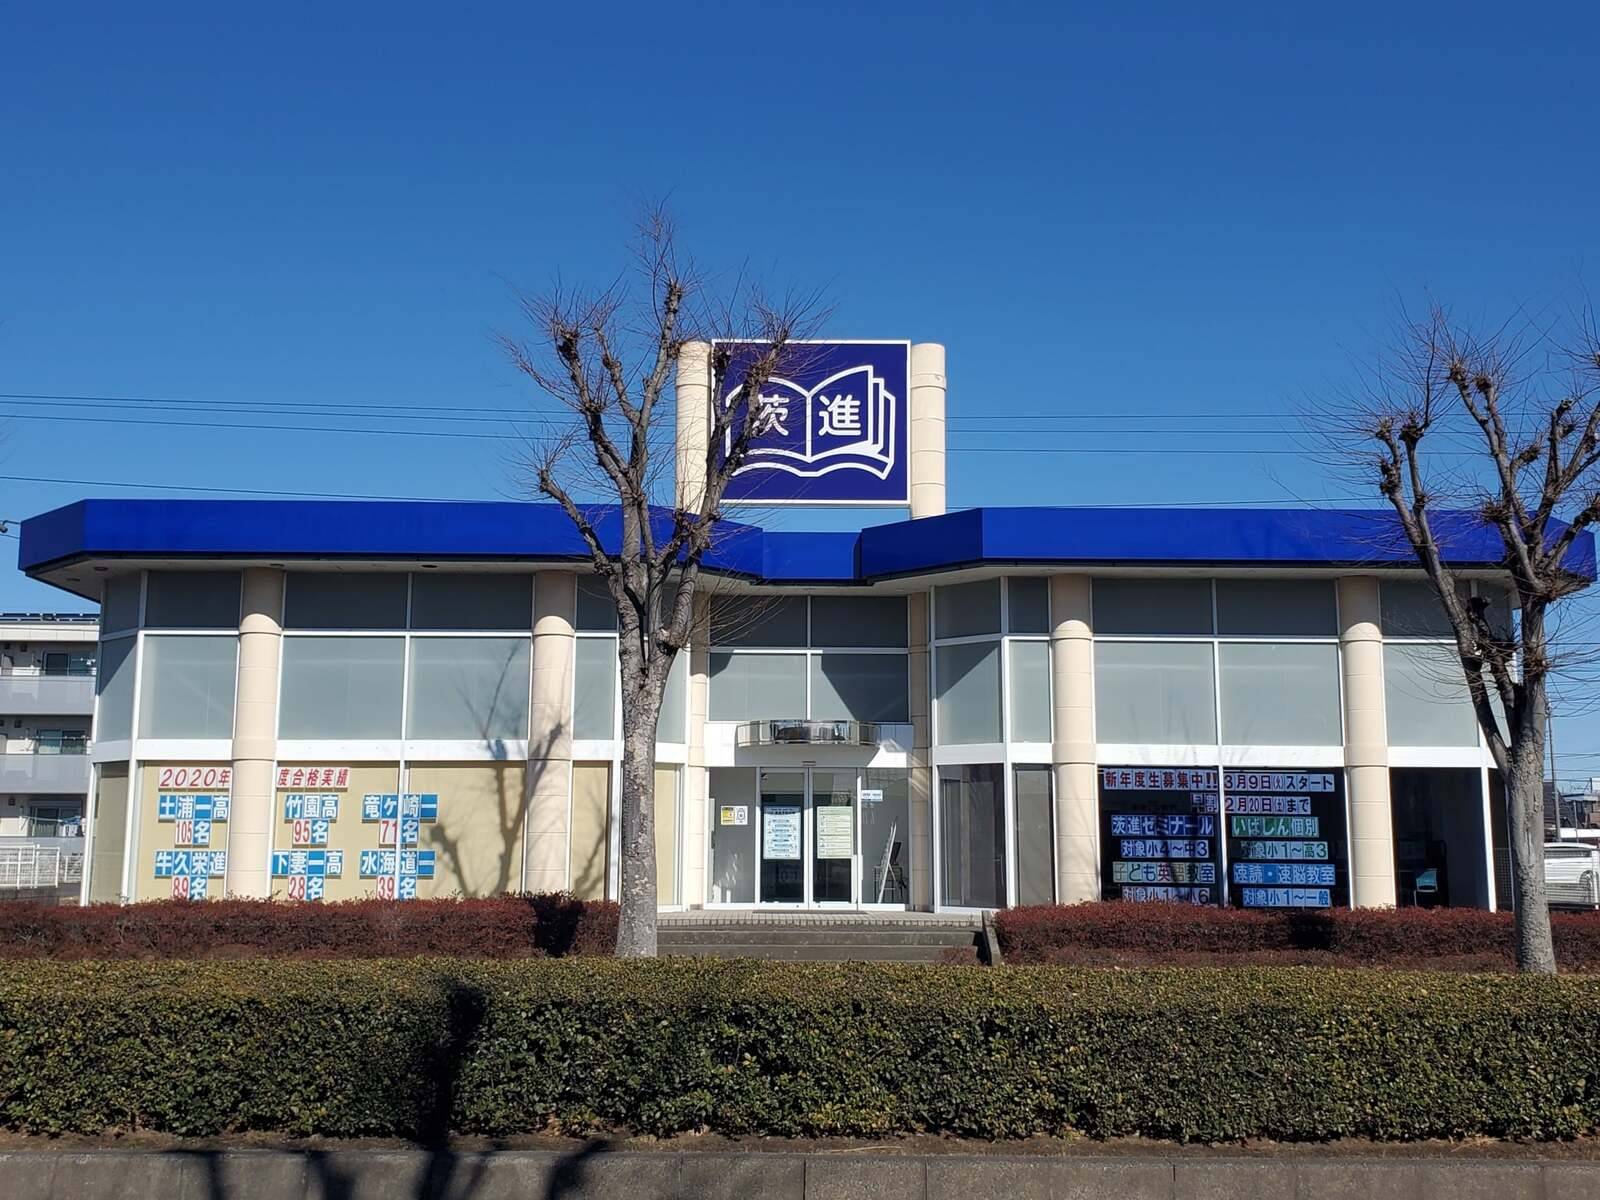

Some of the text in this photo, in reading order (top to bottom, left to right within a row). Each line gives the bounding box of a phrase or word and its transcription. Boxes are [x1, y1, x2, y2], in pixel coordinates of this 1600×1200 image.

[159, 768, 349, 787] 2020年 度合格実績
[159, 795, 228, 819] 土浦一高
[286, 795, 338, 819] 竹園高
[176, 820, 210, 844] 105名
[294, 820, 328, 843] 95名
[381, 820, 419, 843] 71名
[1112, 815, 1213, 836] 茨進ゼミナール
[1233, 817, 1318, 836] いばしん個別
[156, 851, 225, 875] 牛久栄進
[273, 851, 342, 874] 下妻一高
[361, 851, 435, 874] 水海道一
[1114, 863, 1214, 883] 子ども英語教室
[1234, 864, 1335, 884] 速読・速脳教室
[172, 876, 206, 900] 89名
[289, 876, 324, 900] 28名
[378, 876, 416, 900] 39名
